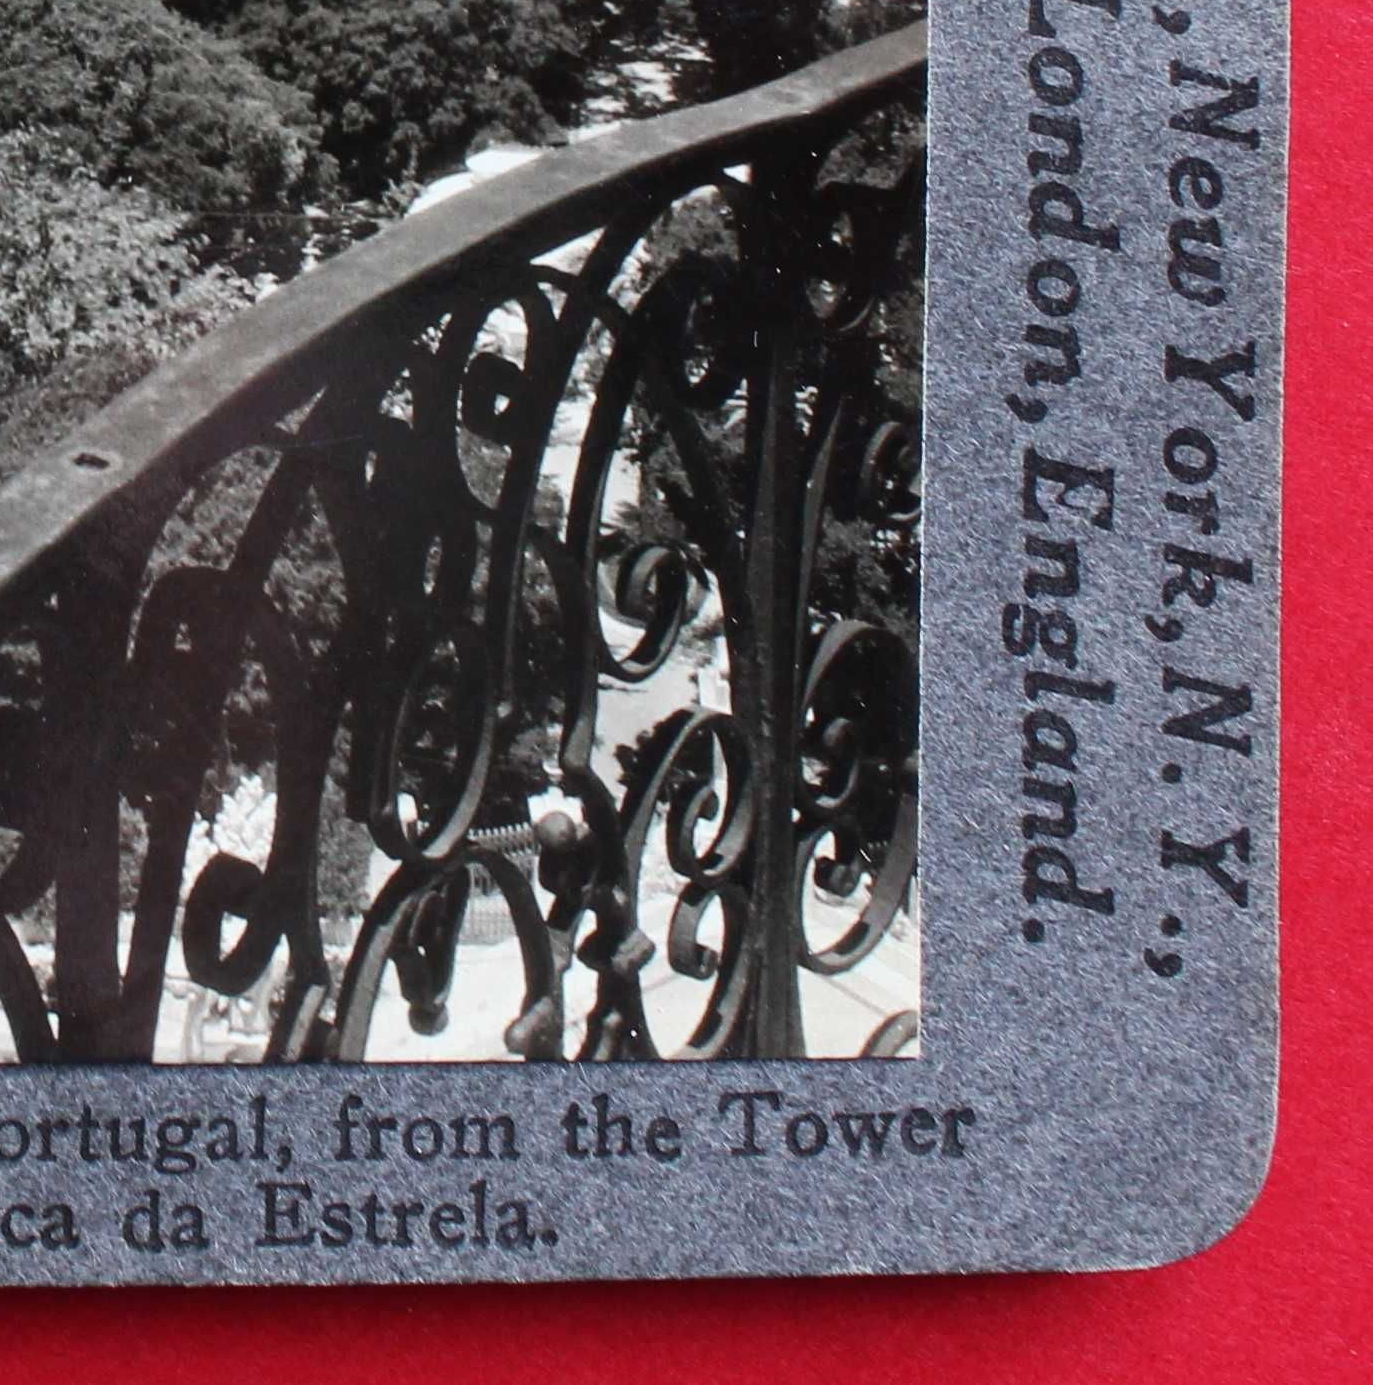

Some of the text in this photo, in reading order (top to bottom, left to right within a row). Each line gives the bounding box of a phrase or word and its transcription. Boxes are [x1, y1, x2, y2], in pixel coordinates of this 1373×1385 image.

[1167, 62, 1260, 306] New
[1146, 341, 1257, 642] York,
[1003, 449, 1116, 943] England.
[123, 1188, 210, 1253] da
[256, 1180, 558, 1249] Estrela.
[335, 1094, 519, 1162] from
[562, 1093, 681, 1161] the
[719, 1091, 976, 1157] Tower
